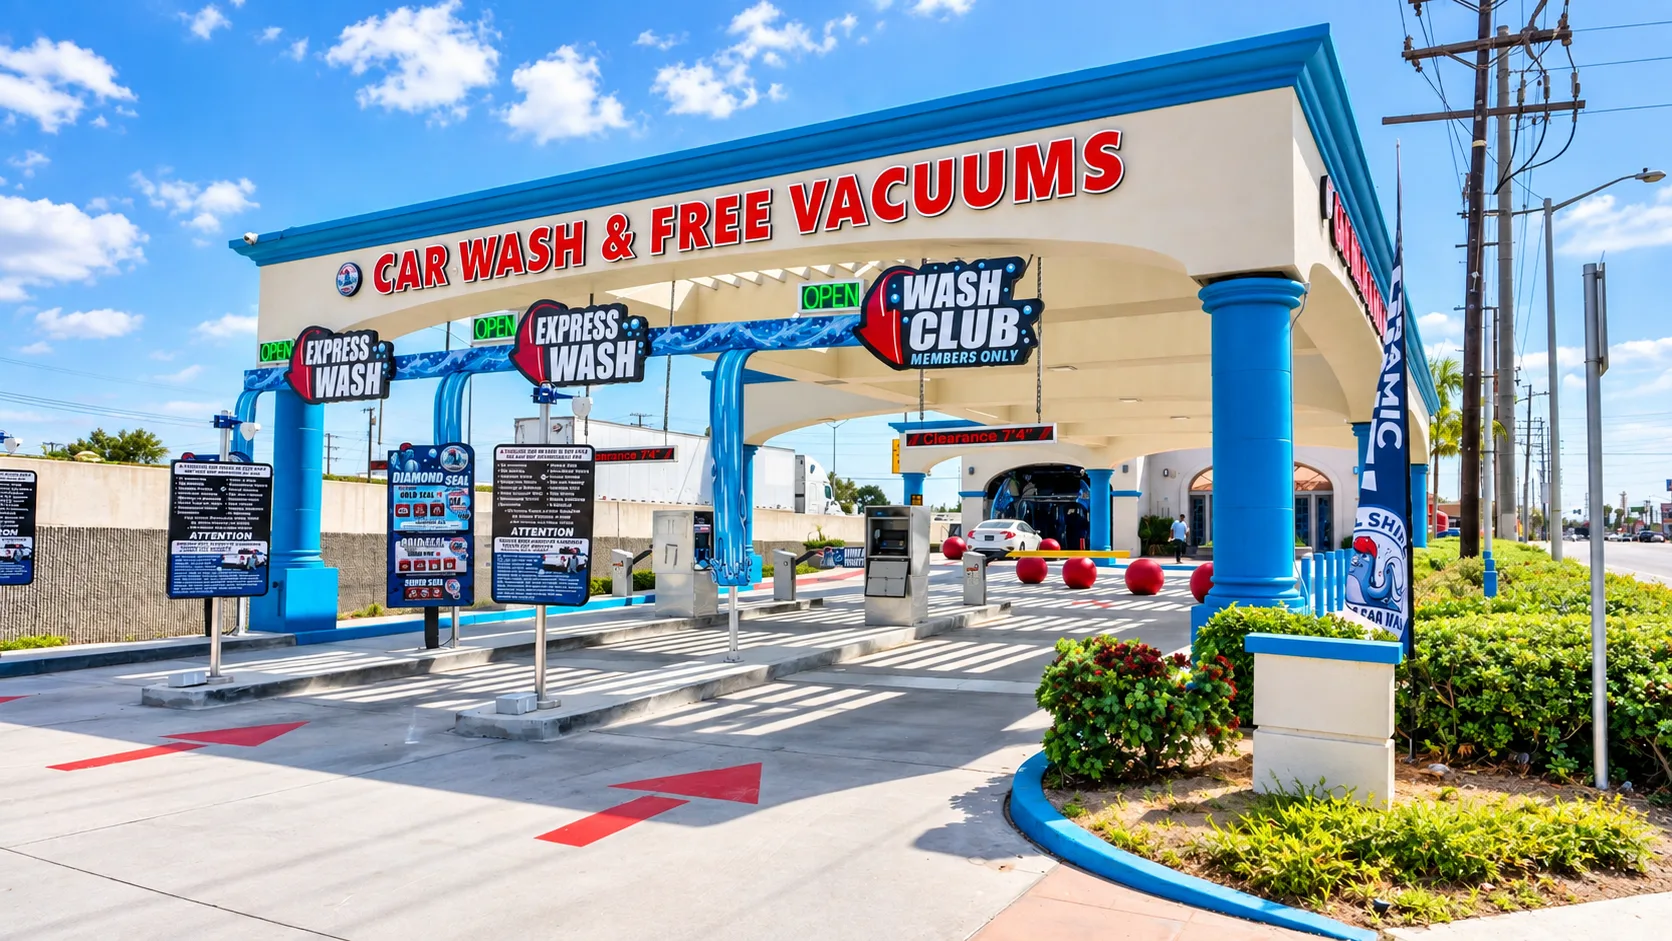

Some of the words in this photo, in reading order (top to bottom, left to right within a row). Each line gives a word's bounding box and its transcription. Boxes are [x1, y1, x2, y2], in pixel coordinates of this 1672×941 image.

[373, 244, 448, 295] CAR
[459, 219, 587, 283] WASH
[601, 212, 636, 263] &
[650, 188, 773, 256] FREE
[788, 130, 1125, 235] VACUUMS
[803, 283, 860, 309] OPEN
[903, 269, 1003, 310] WASH
[475, 315, 516, 339] OPEN
[535, 309, 619, 345] EXPRESS
[909, 307, 1020, 351] CLUB
[261, 342, 293, 362] OPEN
[305, 334, 370, 365] EXPRESS
[550, 339, 637, 382] WASH
[910, 350, 977, 366] MEMBERS
[980, 349, 1019, 363] ONLY
[315, 362, 382, 399] WASH
[923, 431, 998, 445] Clearance
[1002, 428, 1033, 441] 7'4"
[392, 472, 443, 483] DIAMOND
[445, 475, 469, 486] SEAL
[189, 531, 253, 540] ATTENTION
[511, 527, 574, 537] ATTENTION
